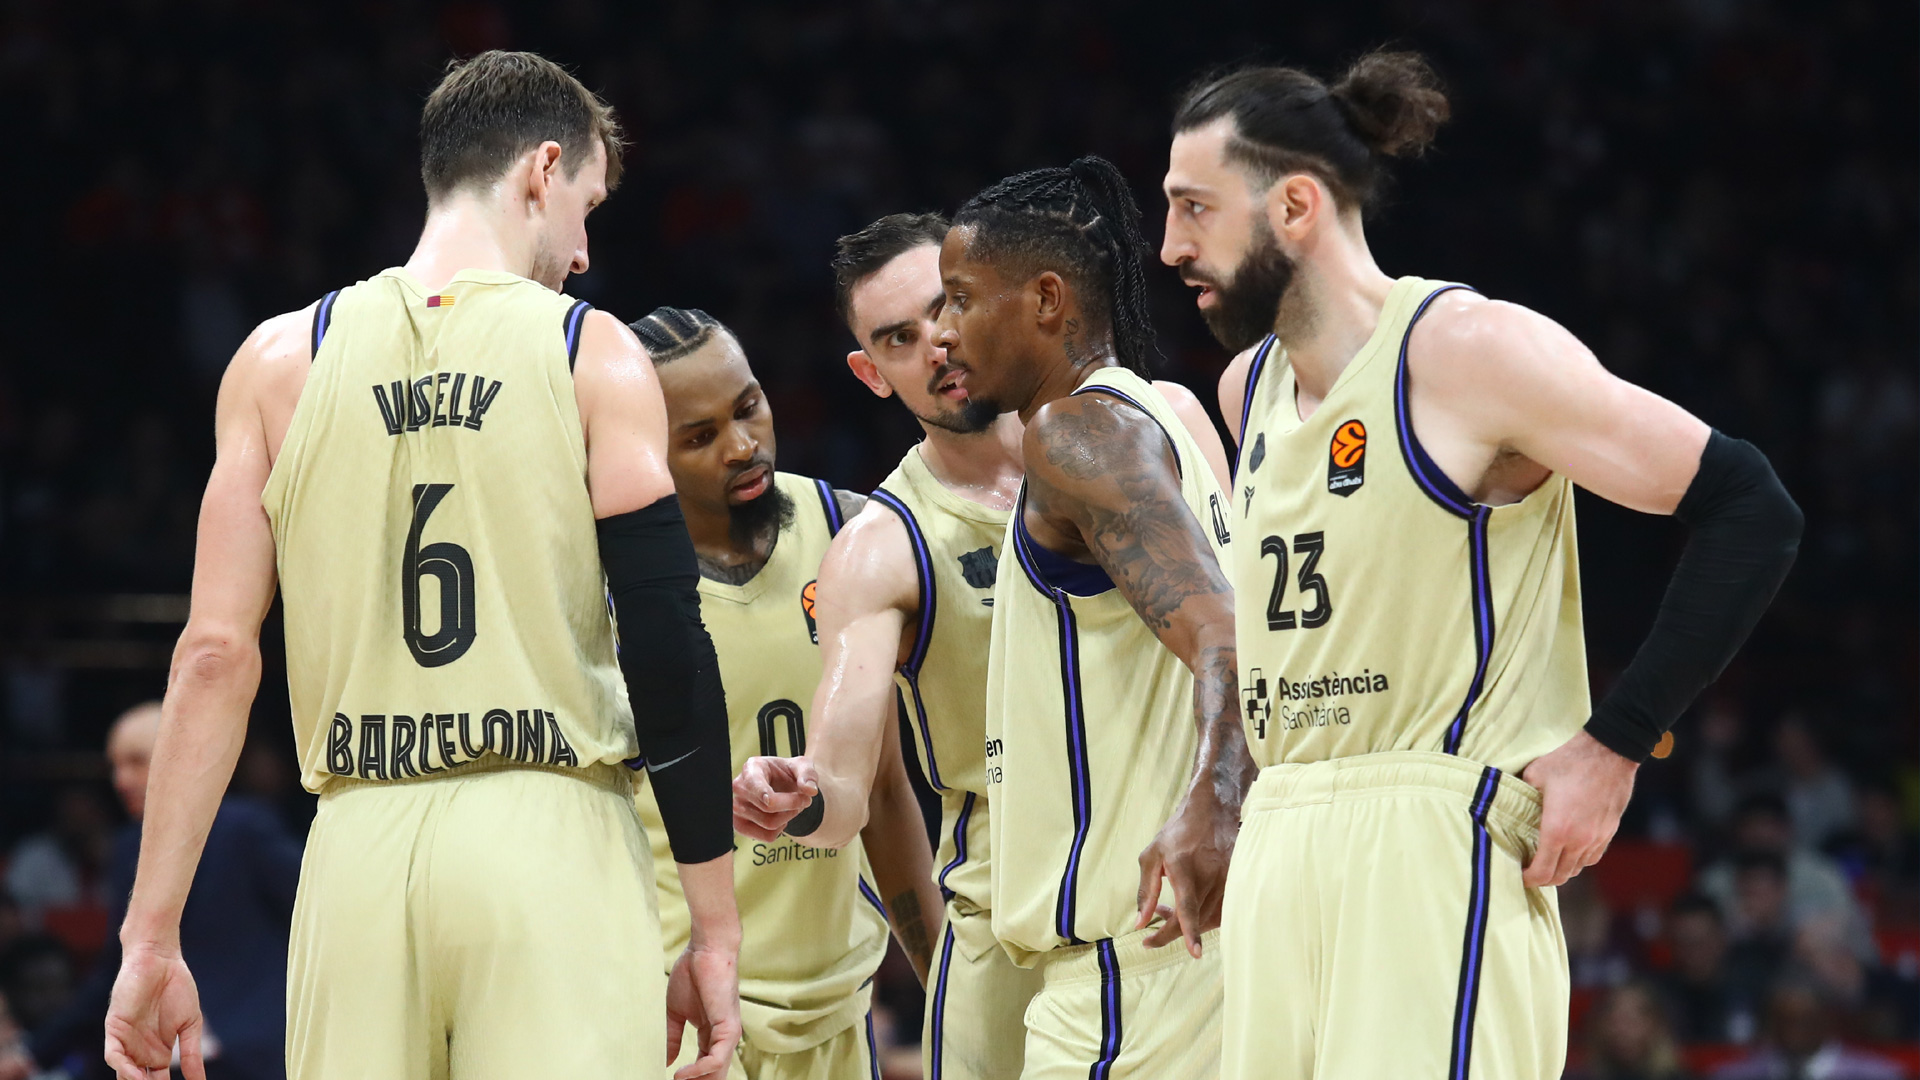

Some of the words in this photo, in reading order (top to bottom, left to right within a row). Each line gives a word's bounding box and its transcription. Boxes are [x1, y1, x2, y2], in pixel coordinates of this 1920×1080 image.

[402, 483, 477, 668] 6
[1261, 530, 1333, 631] 23
[1278, 668, 1389, 701] Assistència
[1281, 702, 1351, 730] Sanitària
[326, 708, 579, 780] BARCELONA
[756, 698, 807, 757] 0
